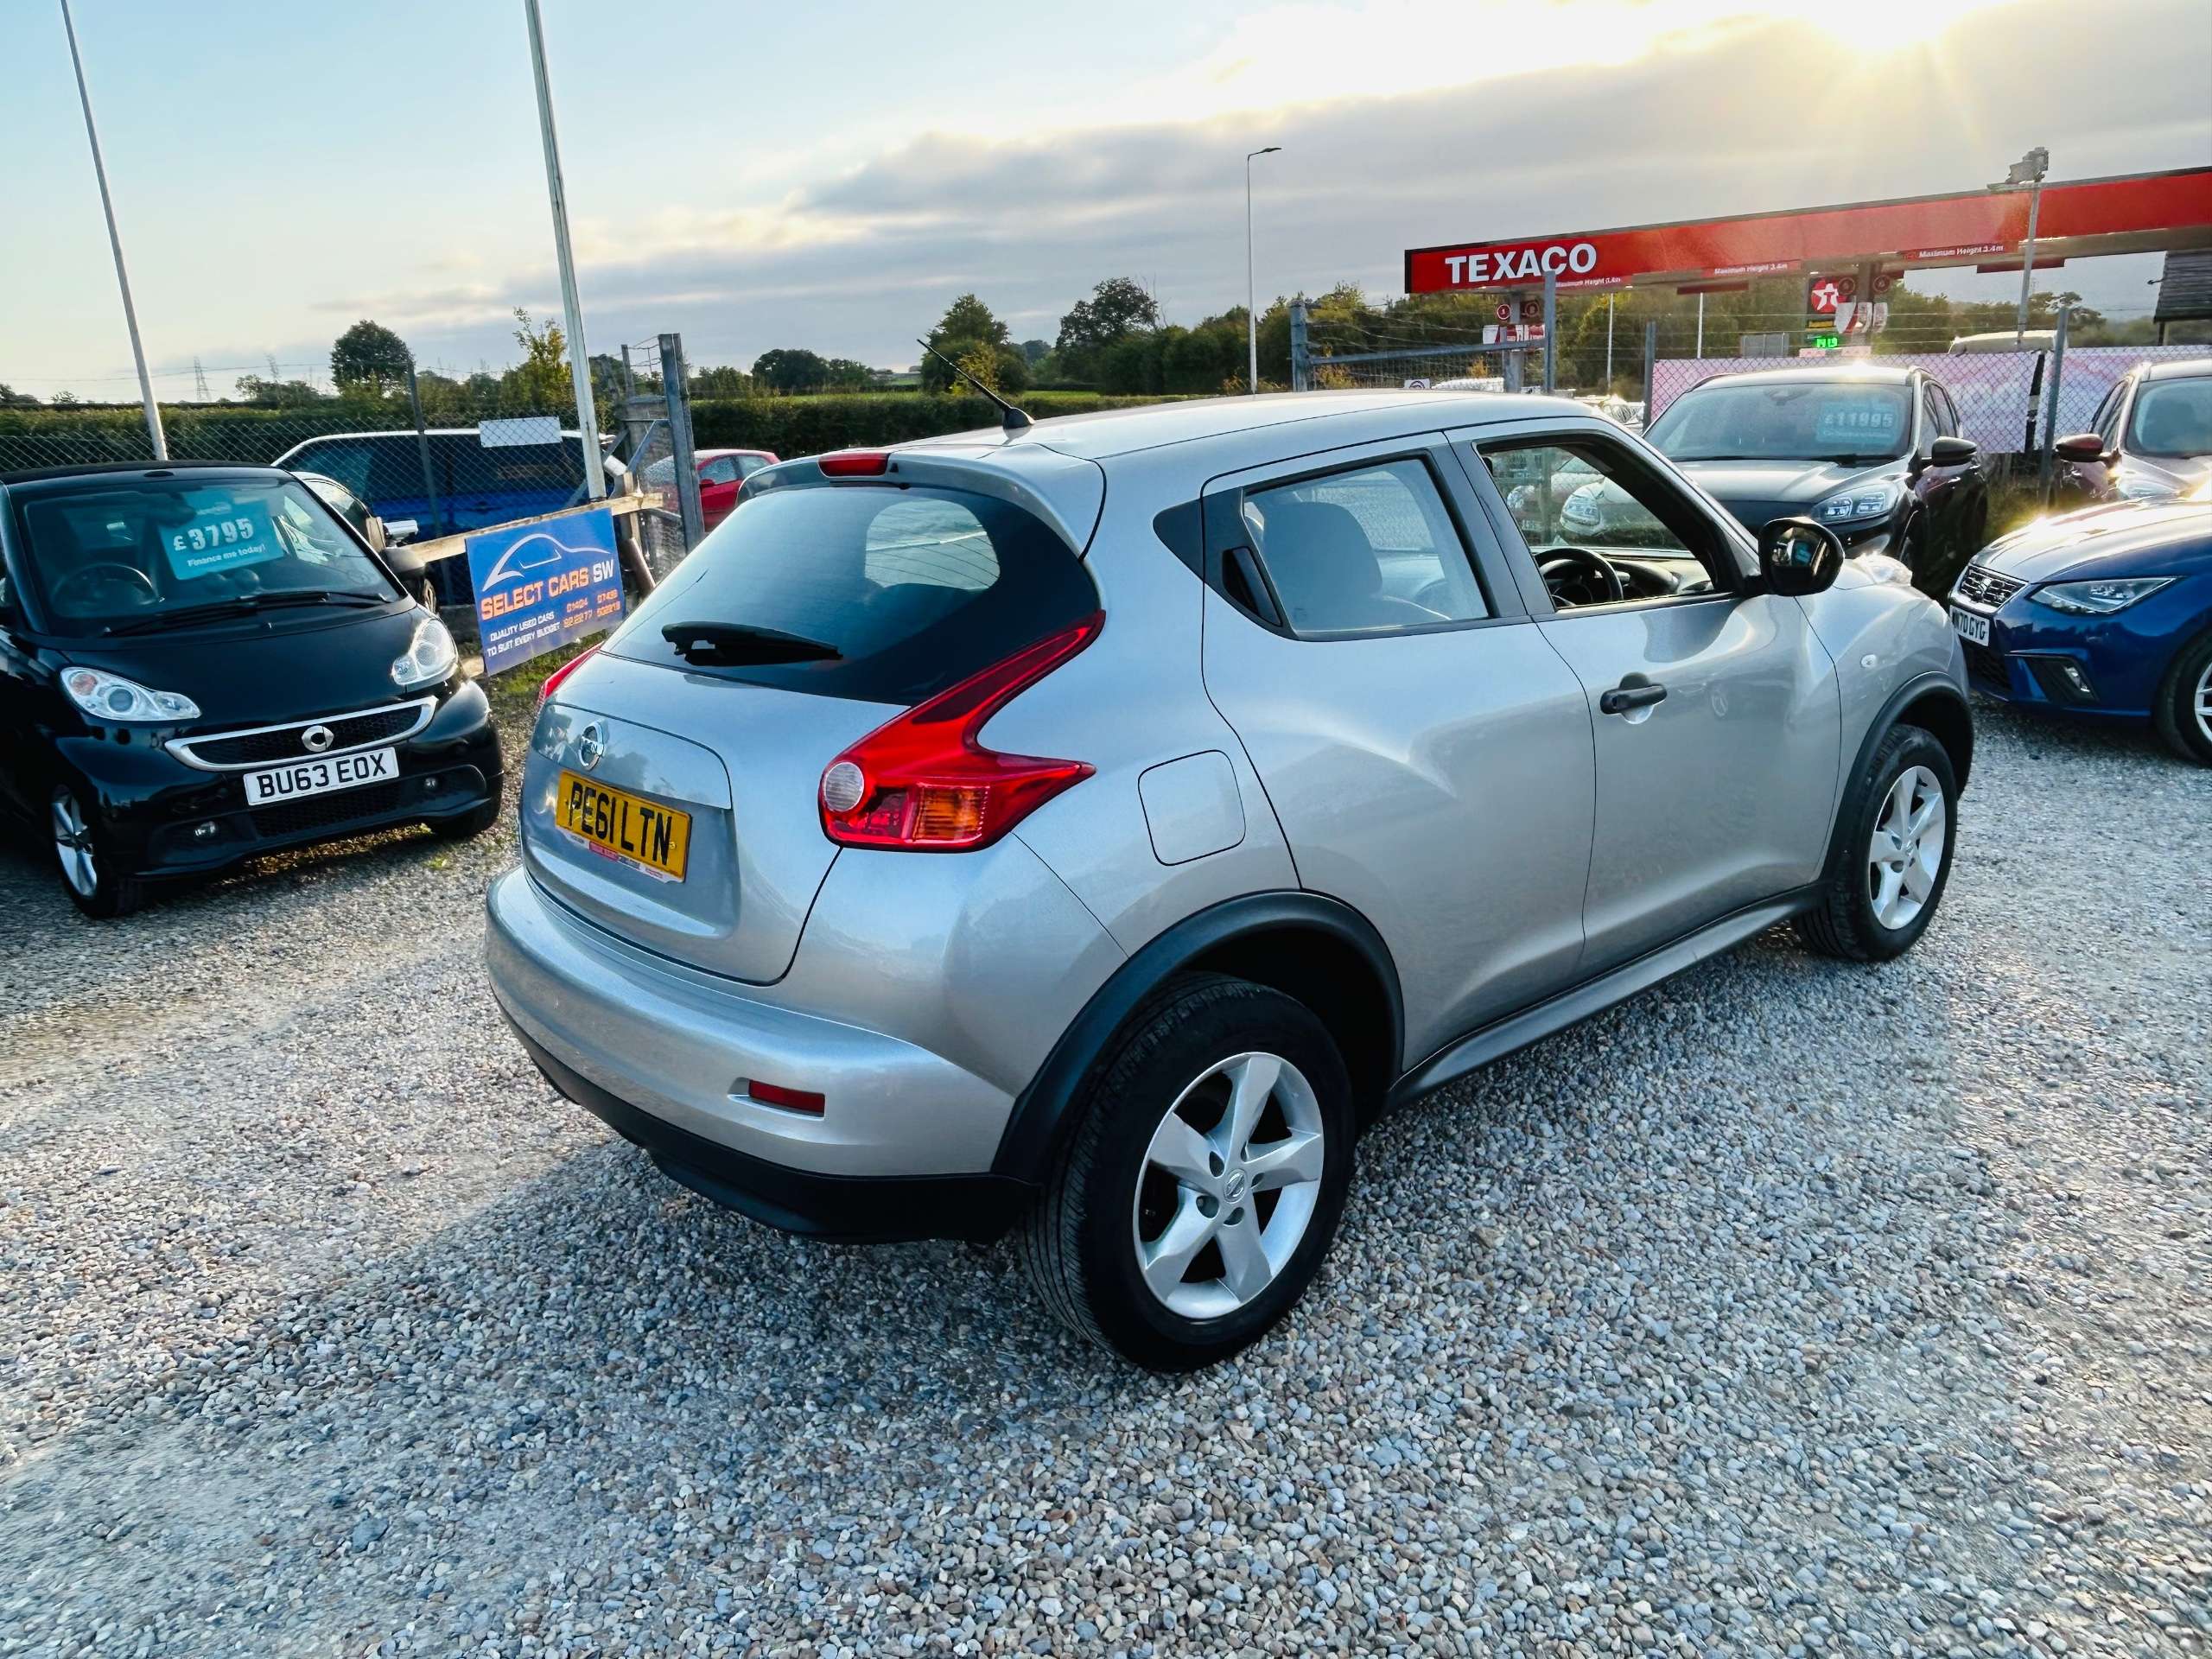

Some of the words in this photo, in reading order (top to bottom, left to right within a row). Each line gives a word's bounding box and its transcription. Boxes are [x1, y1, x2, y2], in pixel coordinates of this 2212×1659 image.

[1445, 243, 1597, 283] TEXACO
[187, 554, 222, 567] Finance
[223, 550, 238, 560] me
[238, 543, 266, 556] today!
[480, 581, 544, 620] SELECT
[548, 567, 589, 597] CARS
[592, 559, 614, 583] SW
[486, 646, 497, 658] TO
[498, 639, 513, 653] SUIT
[514, 632, 536, 648] EVERY
[536, 621, 561, 639] BUDGET
[490, 623, 518, 642] QUALITY
[518, 618, 537, 632] USED
[537, 611, 555, 625] CARS
[257, 764, 329, 798] BU63
[336, 753, 387, 783] EOX
